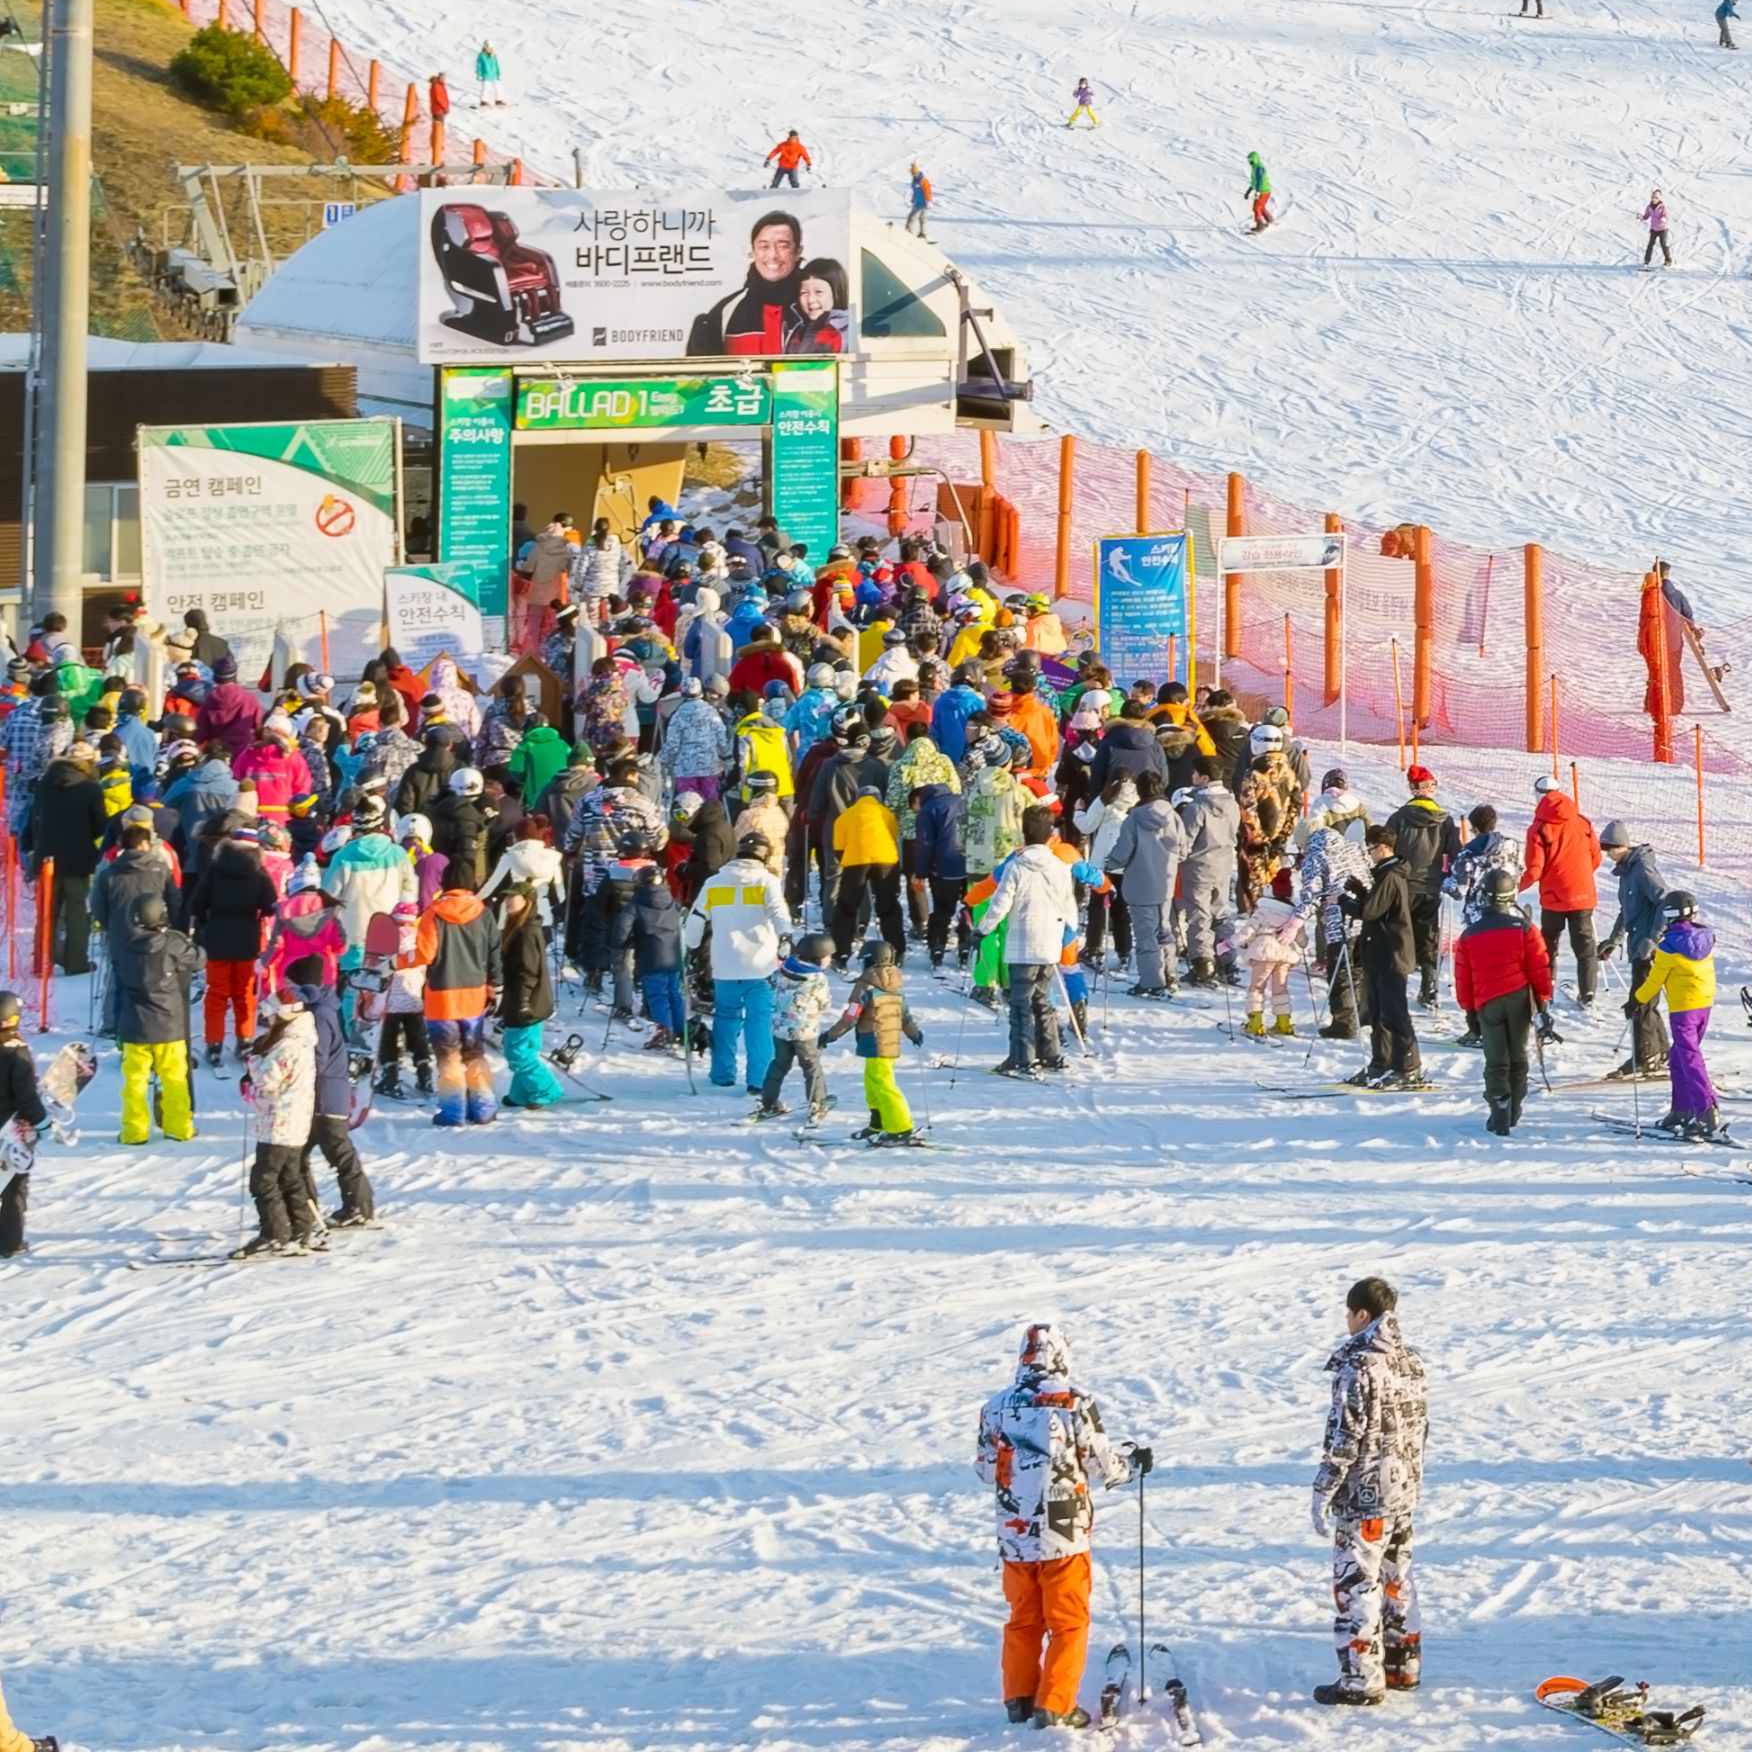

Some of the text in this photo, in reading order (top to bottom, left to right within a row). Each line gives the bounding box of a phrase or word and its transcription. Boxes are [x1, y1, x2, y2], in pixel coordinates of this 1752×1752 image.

[573, 208, 717, 241] 사랑하니까
[576, 244, 714, 277] 바디프랜드
[641, 279, 723, 289] www.bodyfriend.com
[611, 329, 684, 343] BODYFRIEND
[526, 390, 647, 420] BALLAD 1
[650, 391, 677, 403] Easy
[704, 384, 764, 416] 초급
[448, 428, 505, 444] 주의사항
[778, 419, 831, 437] 안전수칙
[164, 475, 262, 498] 금연 캠페인
[210, 590, 264, 612] 캠페인
[398, 591, 432, 605] 스키장
[398, 604, 466, 626] 안전수칙
